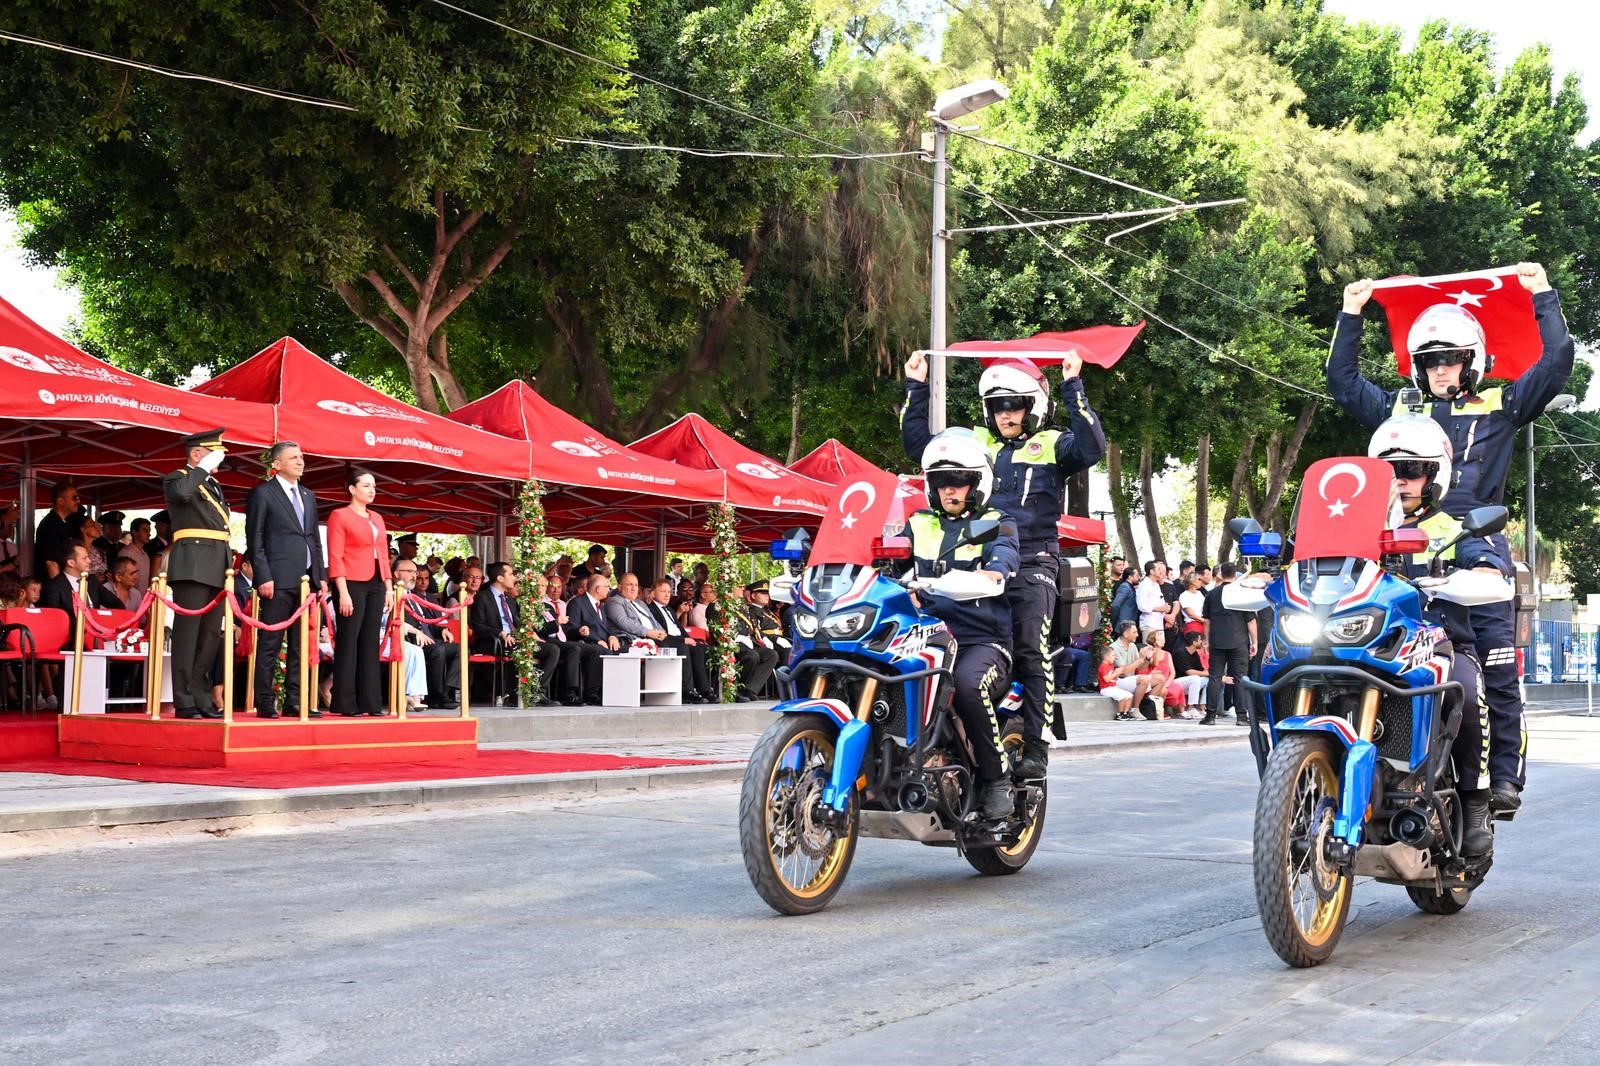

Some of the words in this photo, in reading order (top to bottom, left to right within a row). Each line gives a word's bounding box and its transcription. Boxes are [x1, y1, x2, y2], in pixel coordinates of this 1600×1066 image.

[56, 393, 94, 403] ANTALYA
[95, 393, 139, 409] BÜYÜKŞEHİR
[140, 402, 181, 417] BELEDİYESİ
[375, 436, 402, 445] ANTALYA
